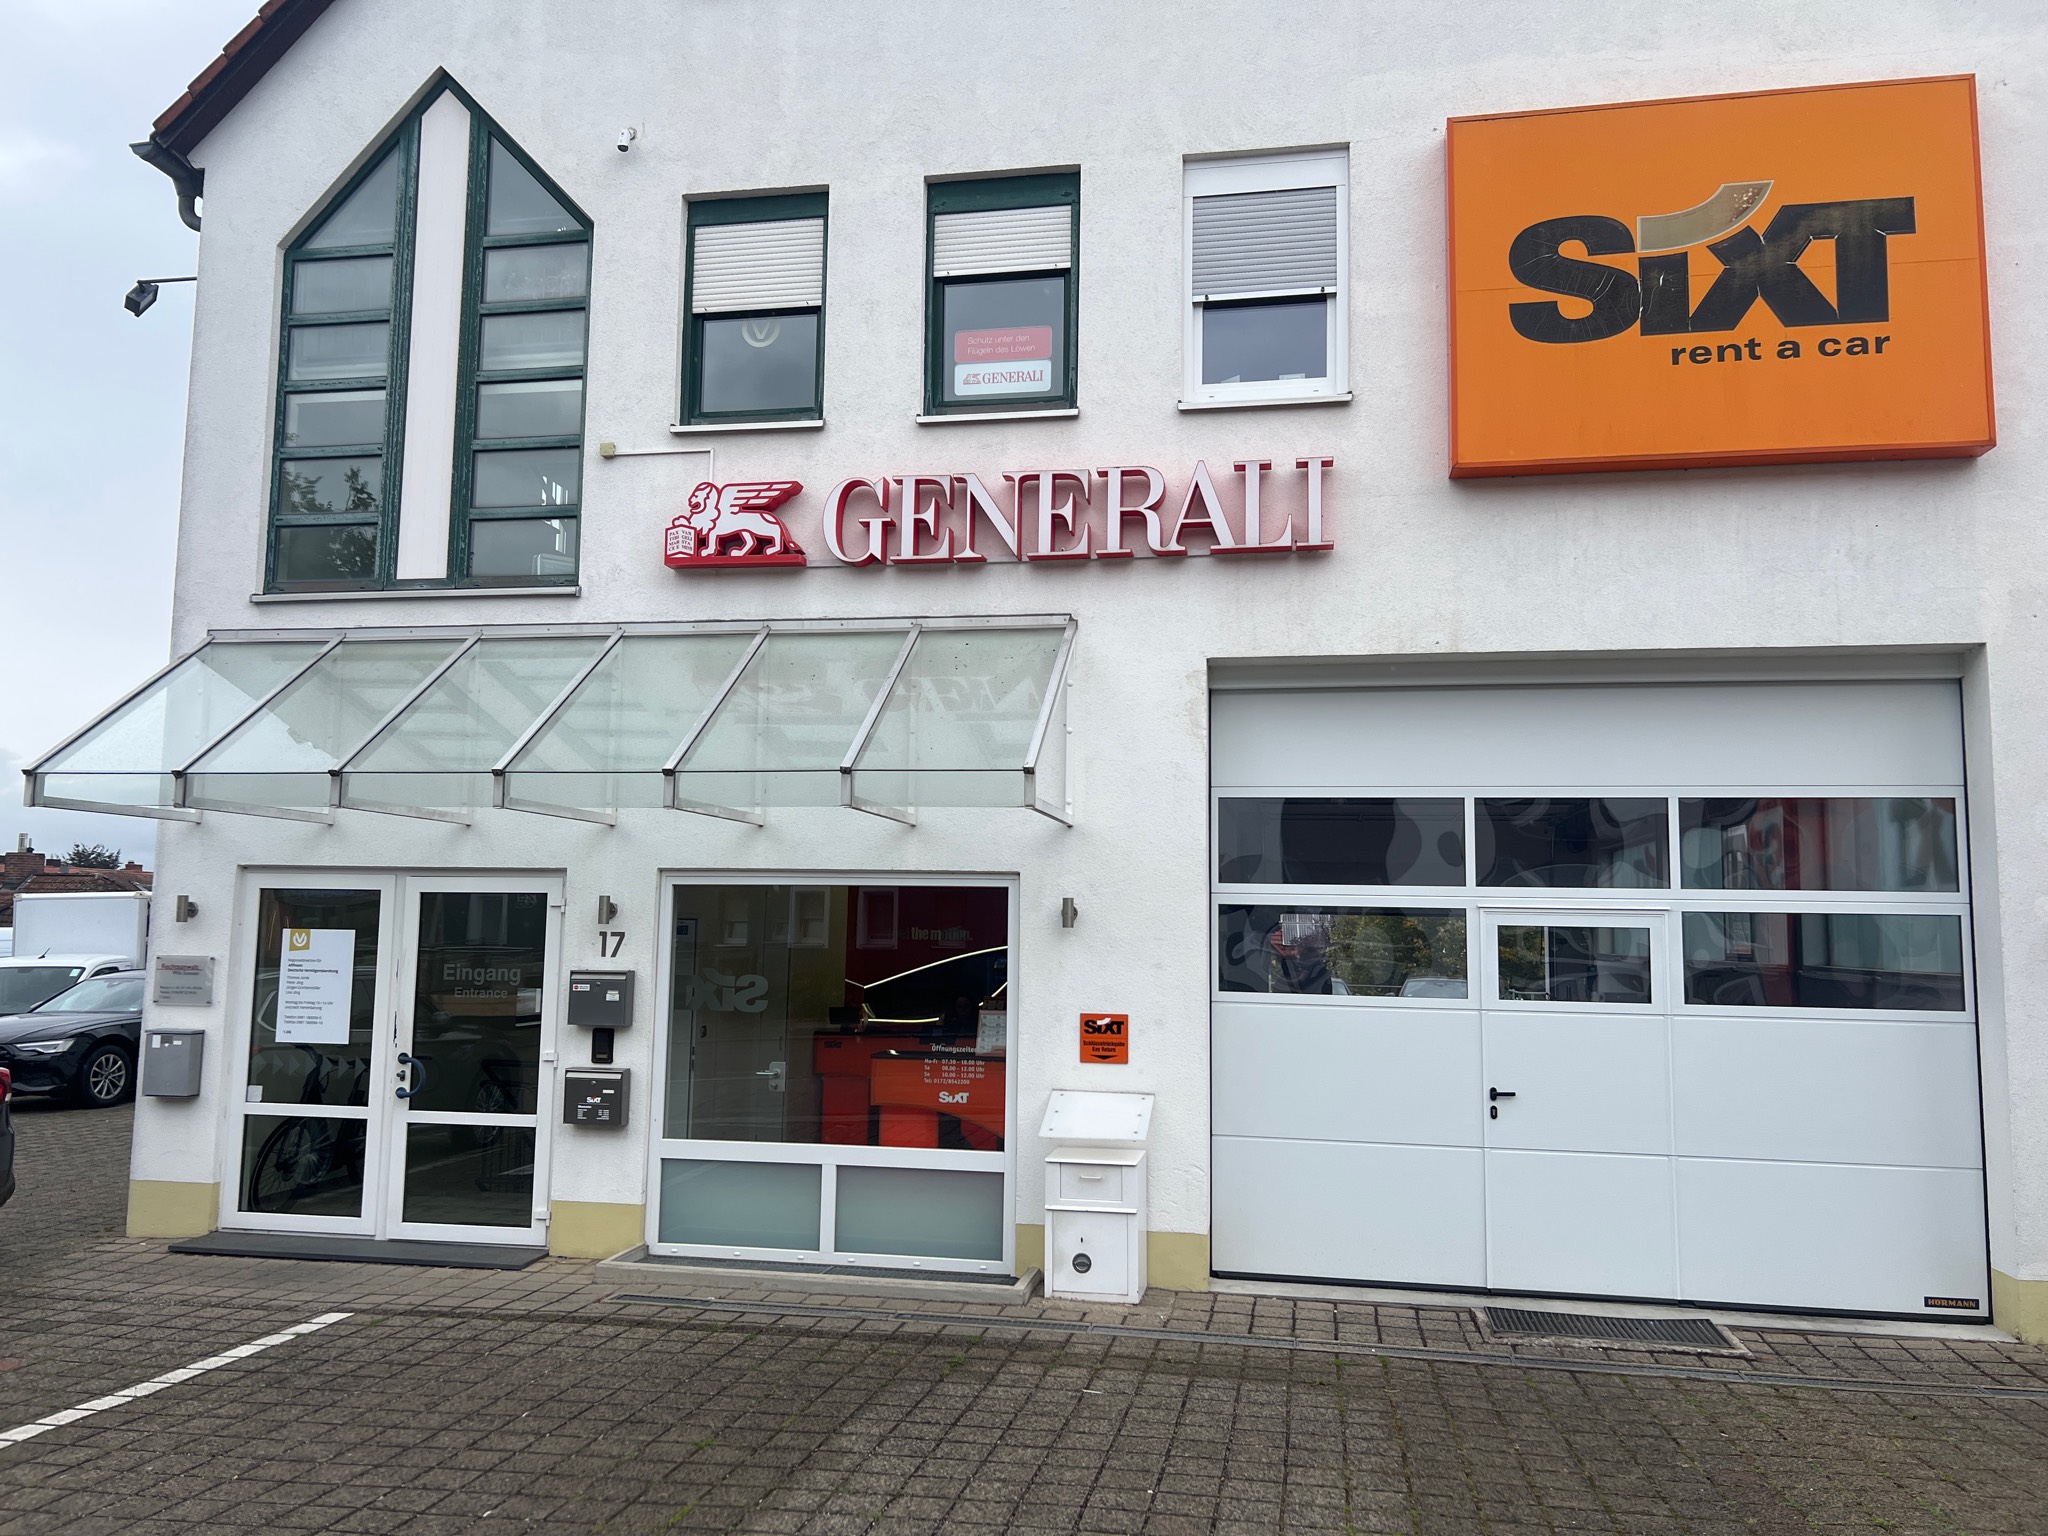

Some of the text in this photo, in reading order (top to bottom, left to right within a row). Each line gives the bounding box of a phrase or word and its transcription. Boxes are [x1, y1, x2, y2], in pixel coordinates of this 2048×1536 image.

[967, 334, 1030, 345] Schutz unter den
[995, 346, 1009, 354] des
[1671, 335, 1891, 365] rent a car
[982, 370, 1044, 384] GENERALI
[822, 456, 1334, 566] GENERALI
[598, 931, 626, 958] 17
[443, 964, 521, 986] Eingang
[454, 987, 508, 999] Entrance
[939, 1091, 970, 1104] SIXT
